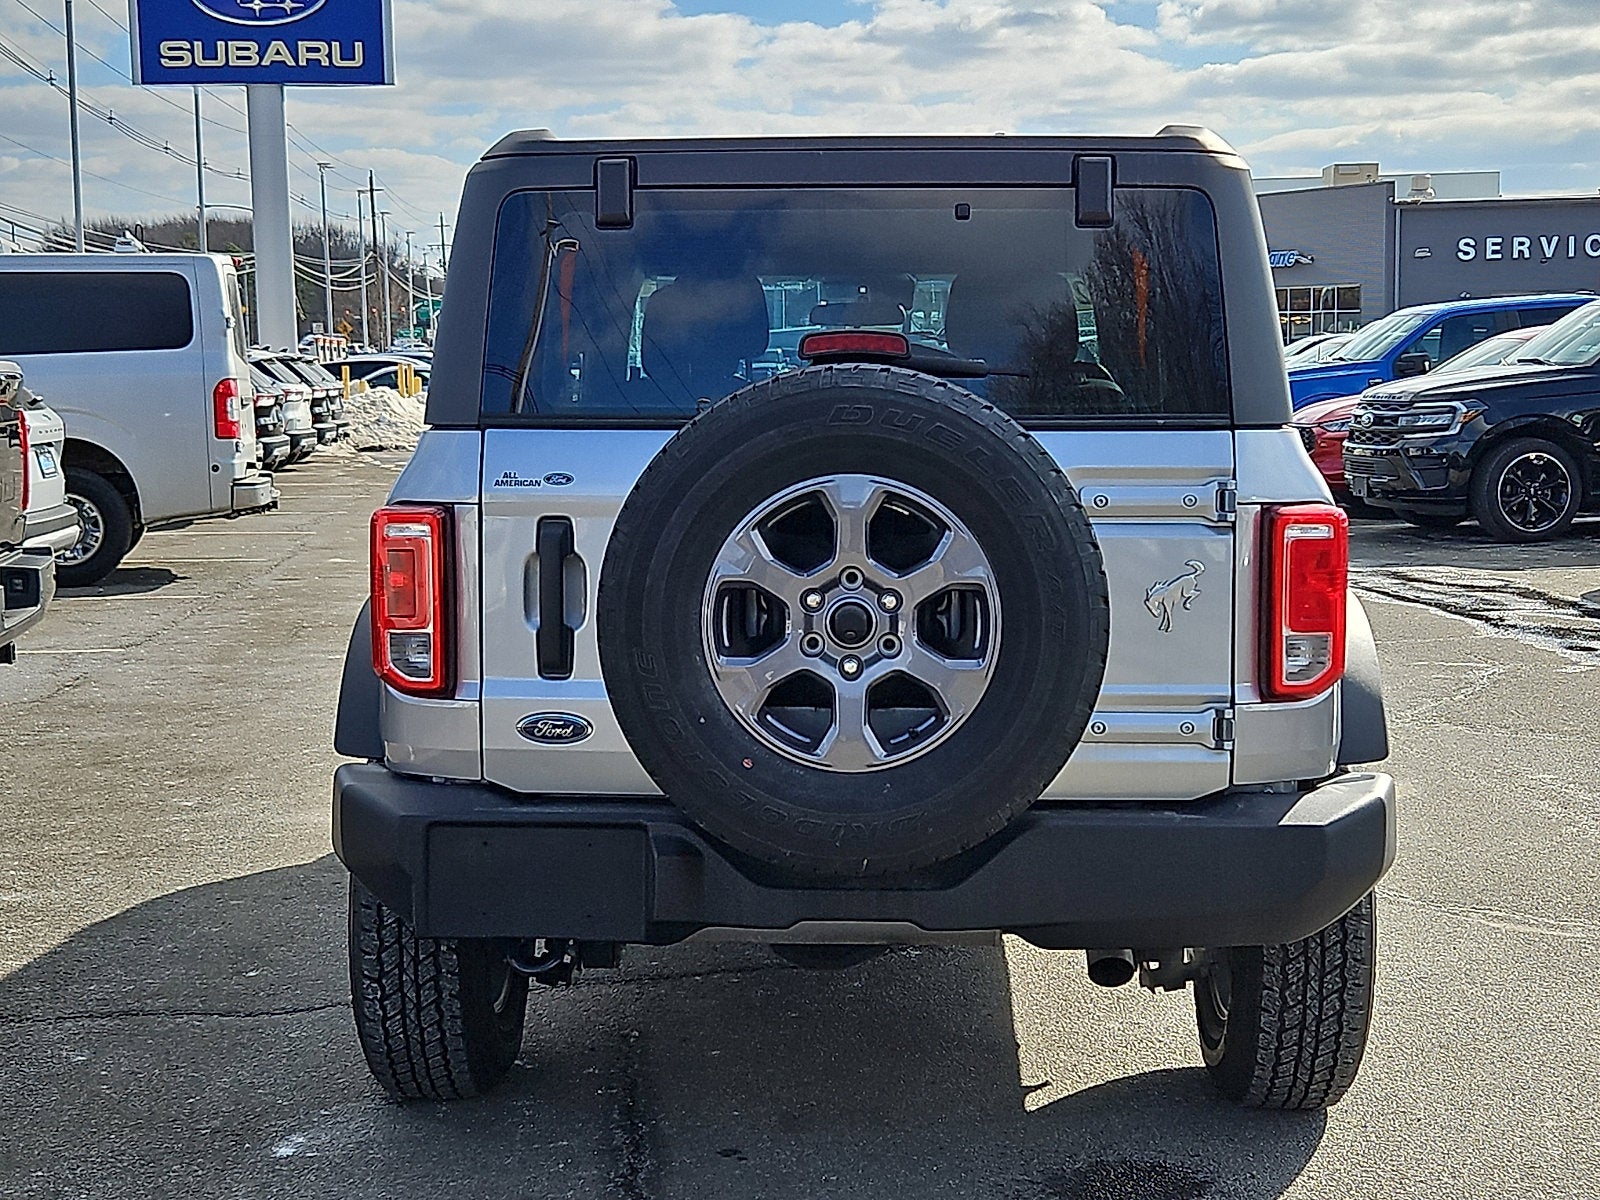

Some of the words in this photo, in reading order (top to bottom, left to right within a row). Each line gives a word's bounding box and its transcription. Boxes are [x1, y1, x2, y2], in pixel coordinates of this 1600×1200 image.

[160, 41, 363, 67] SUBARU
[494, 479, 541, 487] AMERICAN
[502, 471, 519, 479] ALL
[826, 403, 1059, 556] DUELER
[534, 720, 574, 737] Ford
[634, 650, 927, 846] BRIDGESTONE
